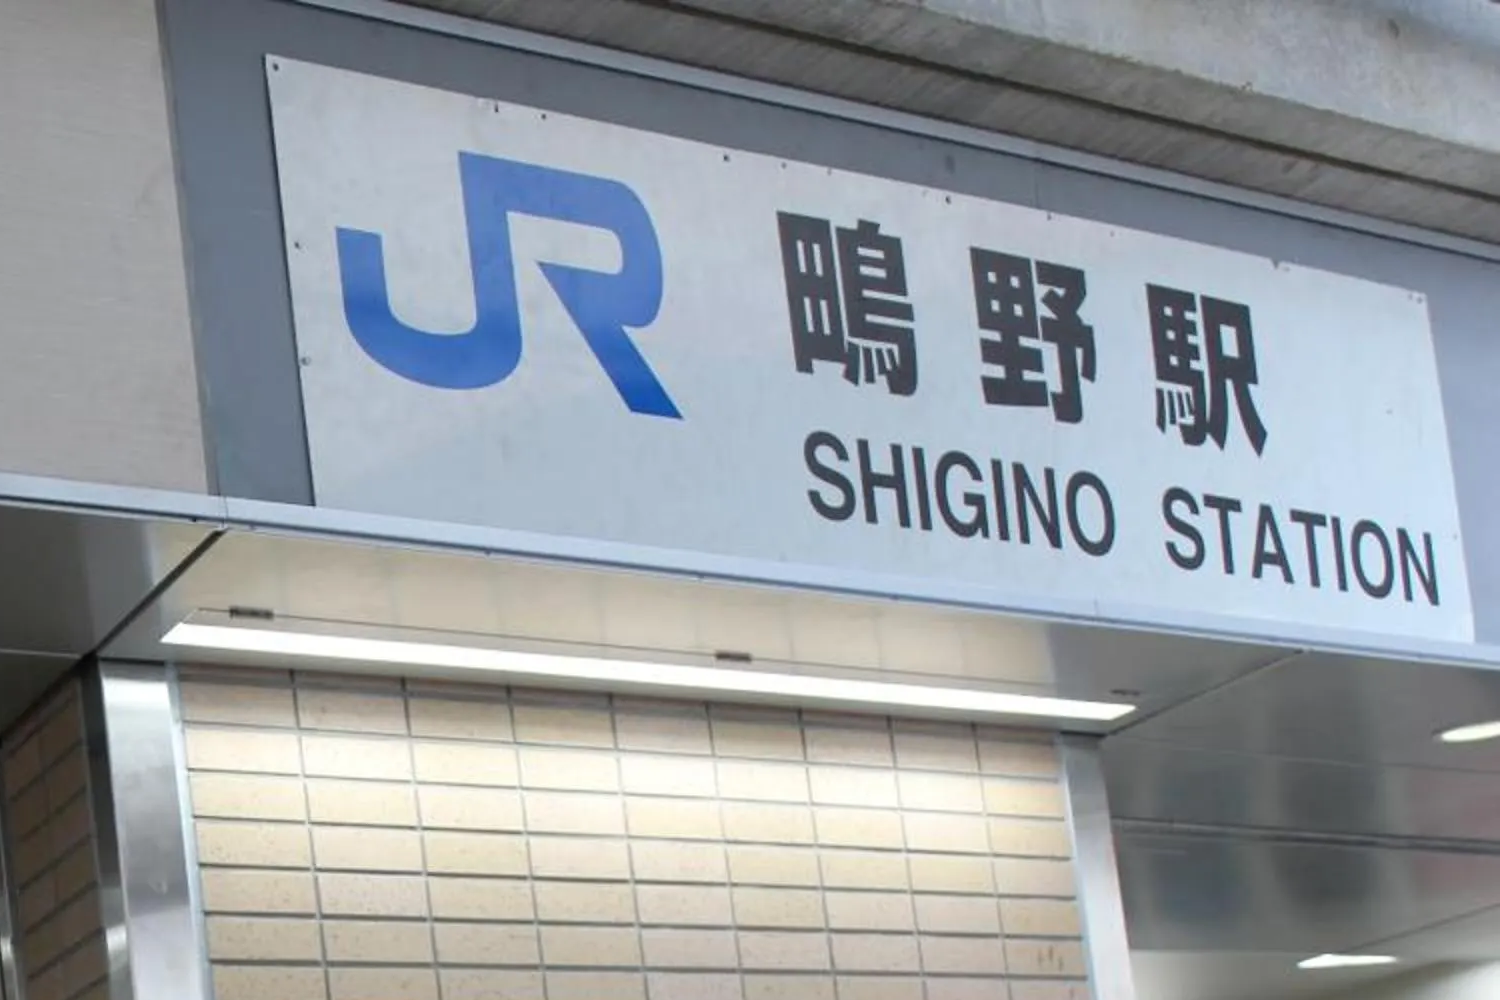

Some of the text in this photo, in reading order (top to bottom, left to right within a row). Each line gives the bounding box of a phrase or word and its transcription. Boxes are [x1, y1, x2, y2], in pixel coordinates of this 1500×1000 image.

[336, 151, 683, 421] JR
[776, 211, 1268, 457] 鴫野駅
[804, 431, 1441, 607] SHIGINO STATION
